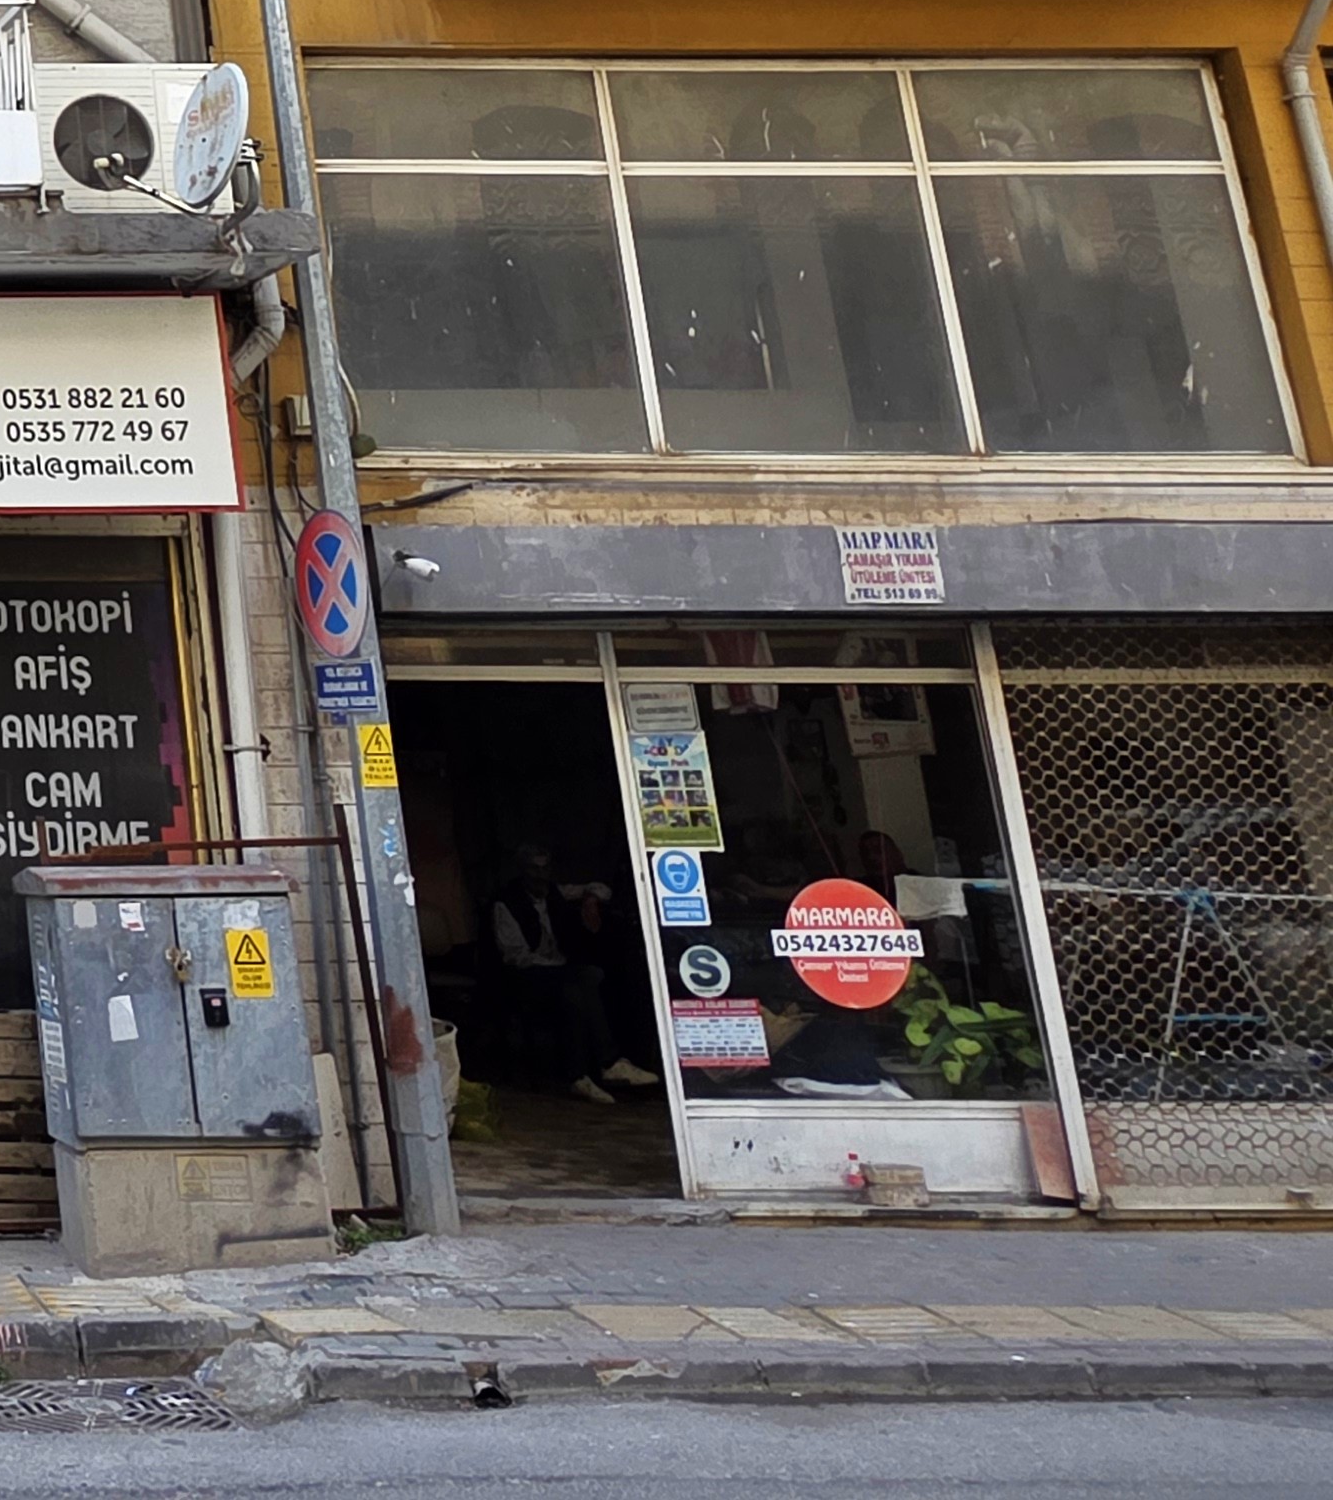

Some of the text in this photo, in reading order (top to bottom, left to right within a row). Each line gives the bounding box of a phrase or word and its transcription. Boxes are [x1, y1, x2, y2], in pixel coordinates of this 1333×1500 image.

[2, 387, 186, 409] 0531 882 21 60
[6, 420, 189, 443] 0535 772 49 67
[855, 587, 882, 600] TEL:
[884, 587, 906, 600] 513
[14, 645, 92, 695] AFİŞ
[24, 771, 102, 808] CAM
[789, 906, 896, 927] MARMARA
[776, 934, 920, 952] 05424327648
